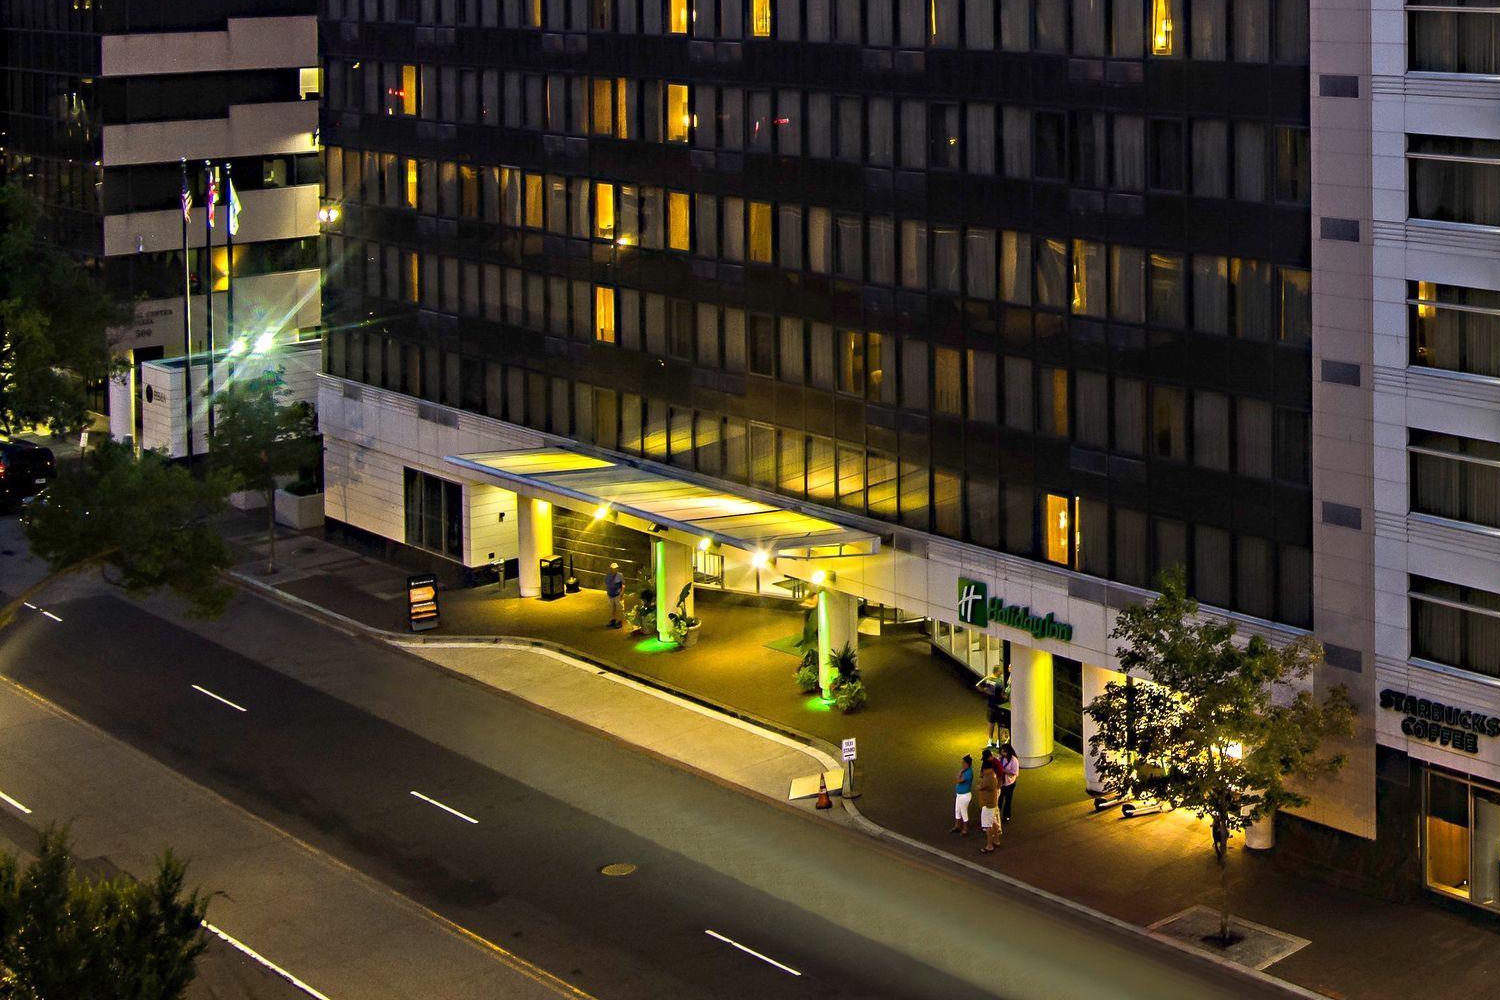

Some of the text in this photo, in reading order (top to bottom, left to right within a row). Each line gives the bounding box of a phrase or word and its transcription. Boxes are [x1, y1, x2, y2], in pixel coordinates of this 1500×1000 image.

[987, 596, 1073, 642] Holiday Inn
[1380, 689, 1500, 737] STARBUCKS
[1401, 716, 1479, 754] COFFEE
